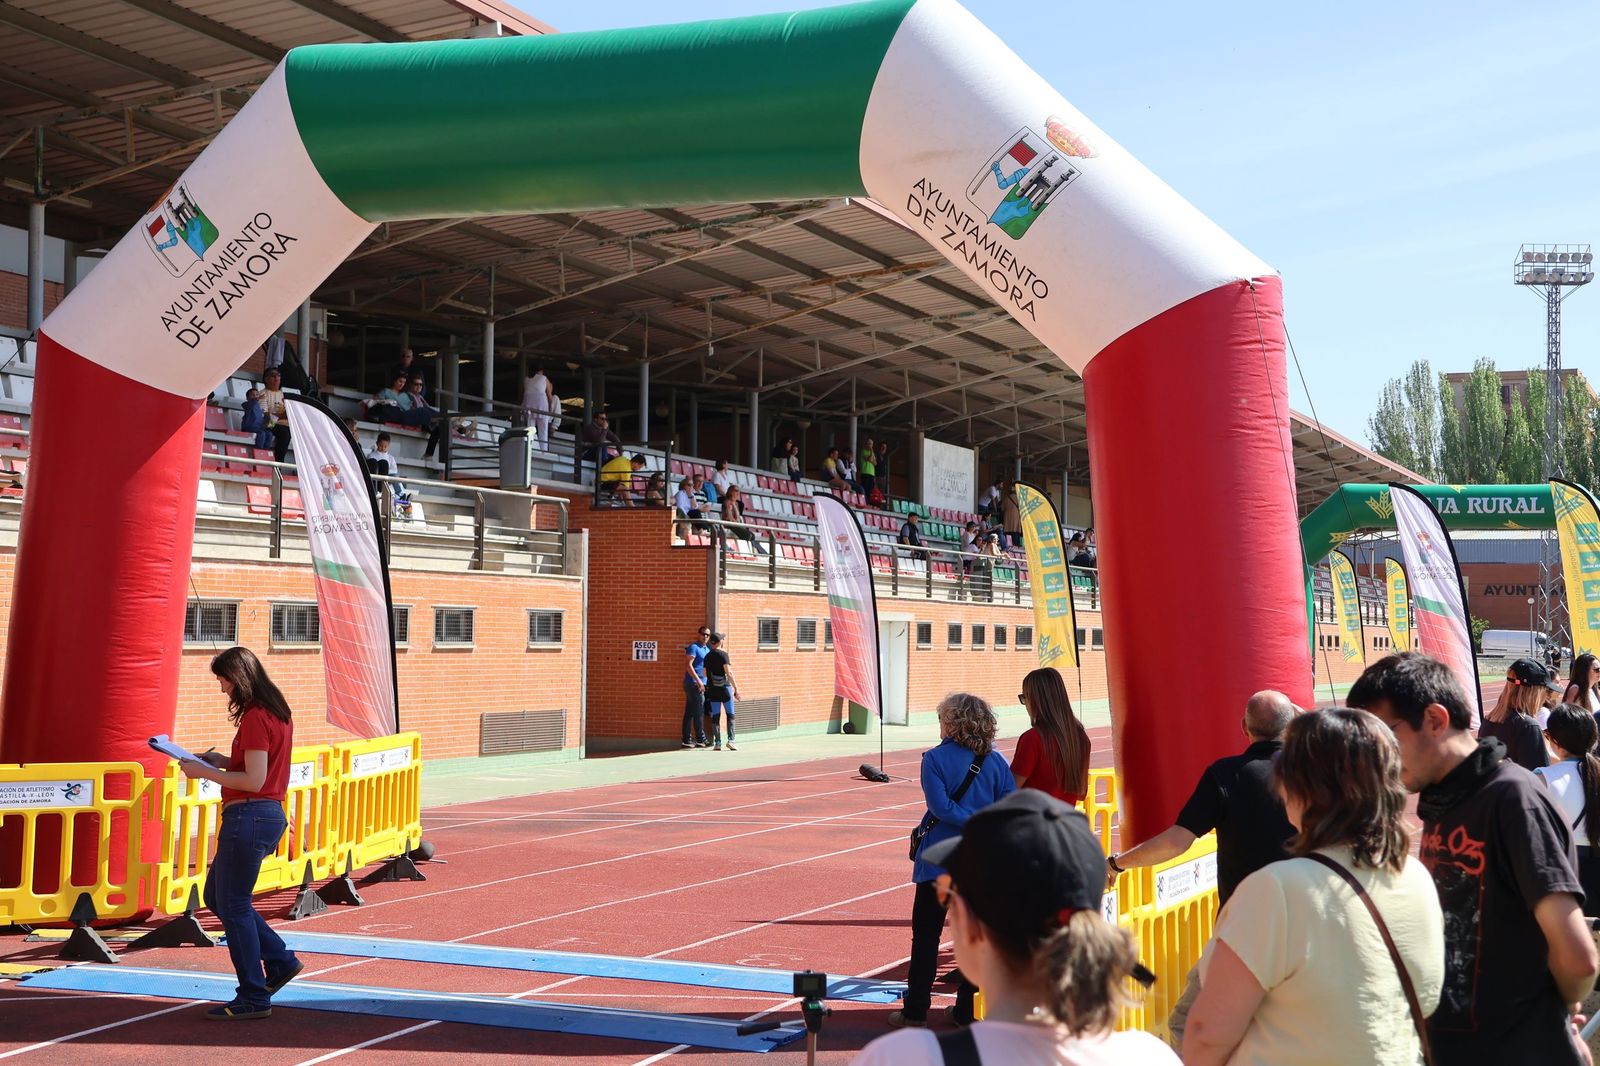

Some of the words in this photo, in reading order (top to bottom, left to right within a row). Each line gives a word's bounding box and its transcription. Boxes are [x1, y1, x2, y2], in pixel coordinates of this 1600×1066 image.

[160, 212, 274, 332] AYUNTAMIENTO
[176, 316, 214, 349] DE
[204, 232, 298, 320] ZAMORA
[906, 194, 936, 230] DE
[941, 225, 1036, 322] ZAMORA
[912, 177, 1048, 299] AYUNTAMIENTO
[1467, 497, 1545, 514] RURAL
